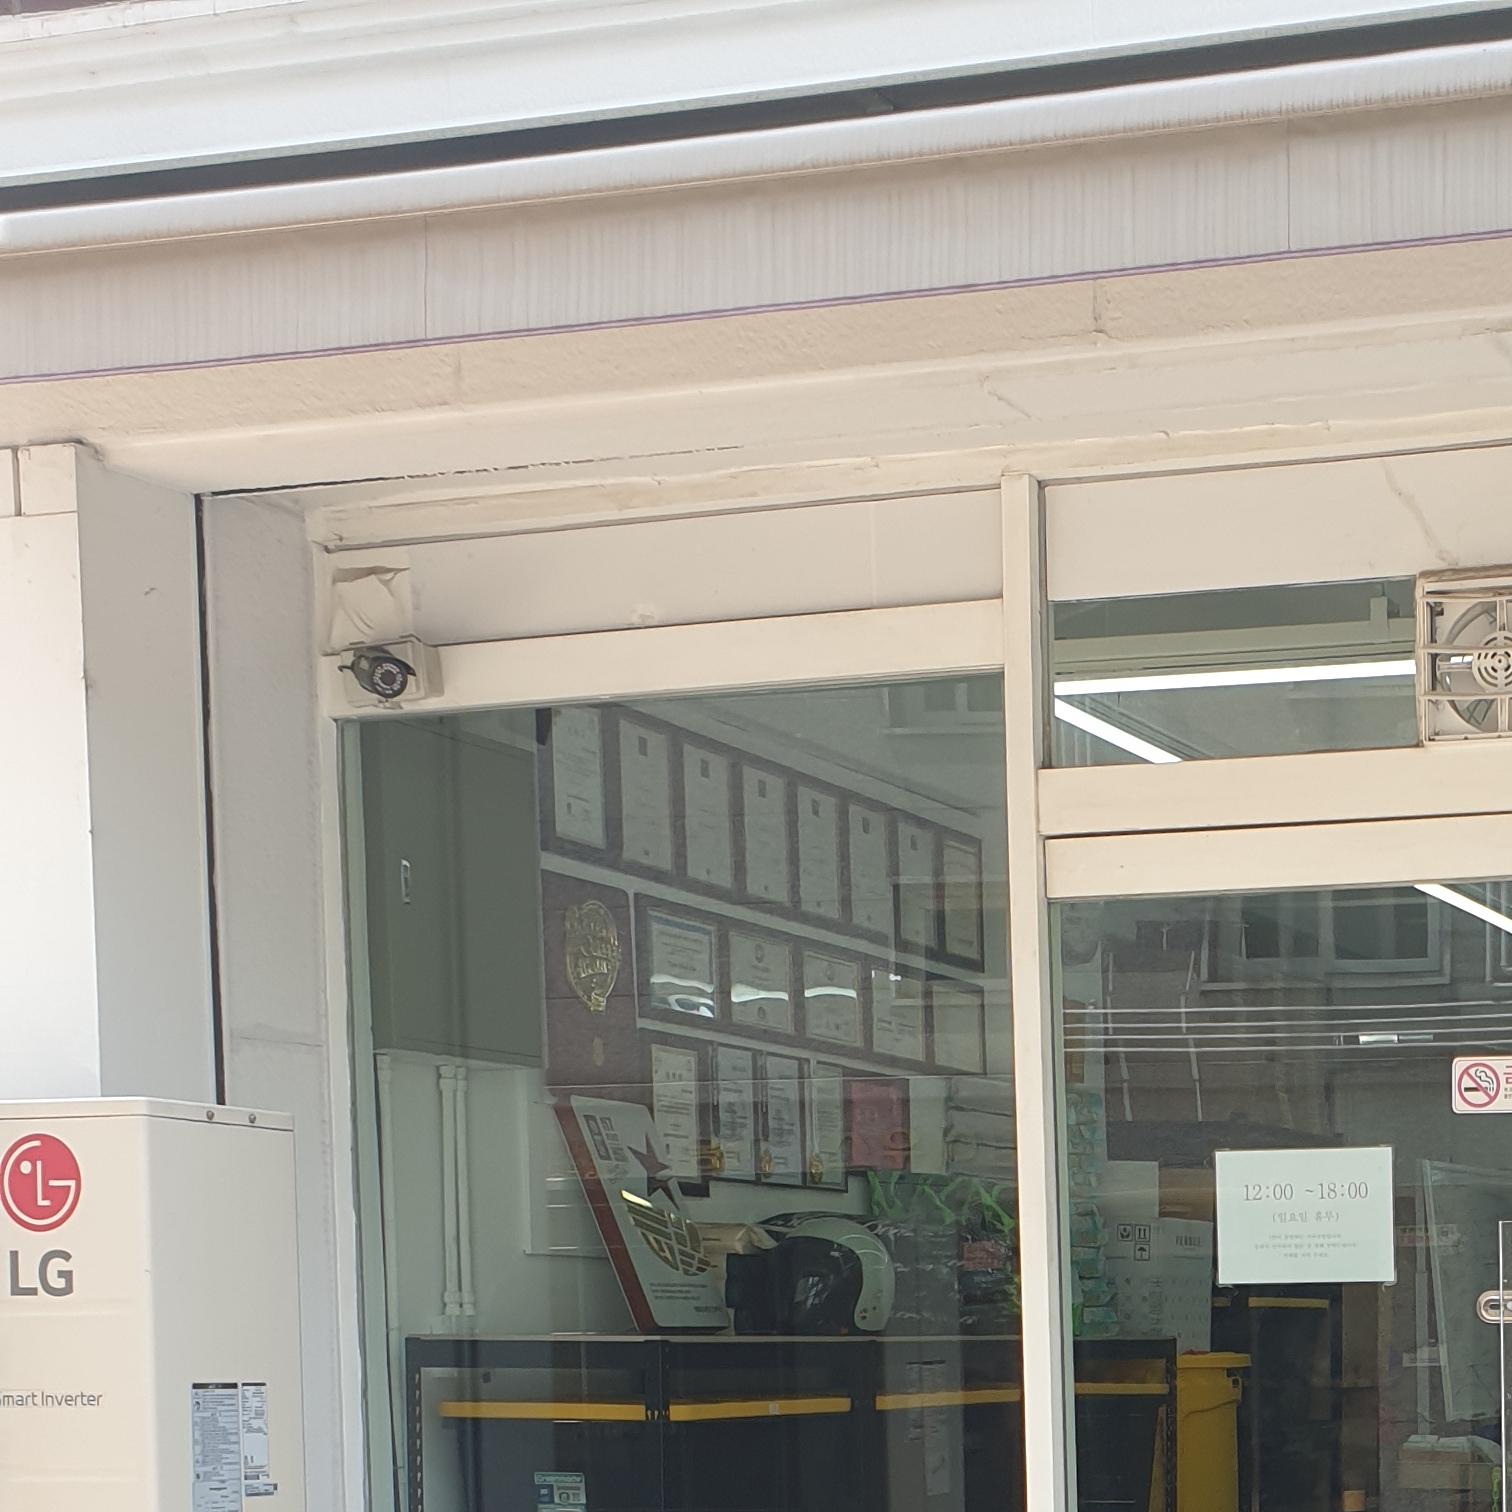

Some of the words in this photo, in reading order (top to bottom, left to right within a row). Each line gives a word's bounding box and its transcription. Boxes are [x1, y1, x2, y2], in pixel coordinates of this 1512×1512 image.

[1243, 1183, 1294, 1201] 12:00
[9, 1249, 75, 1297] LG
[41, 1391, 103, 1407] Inverter
